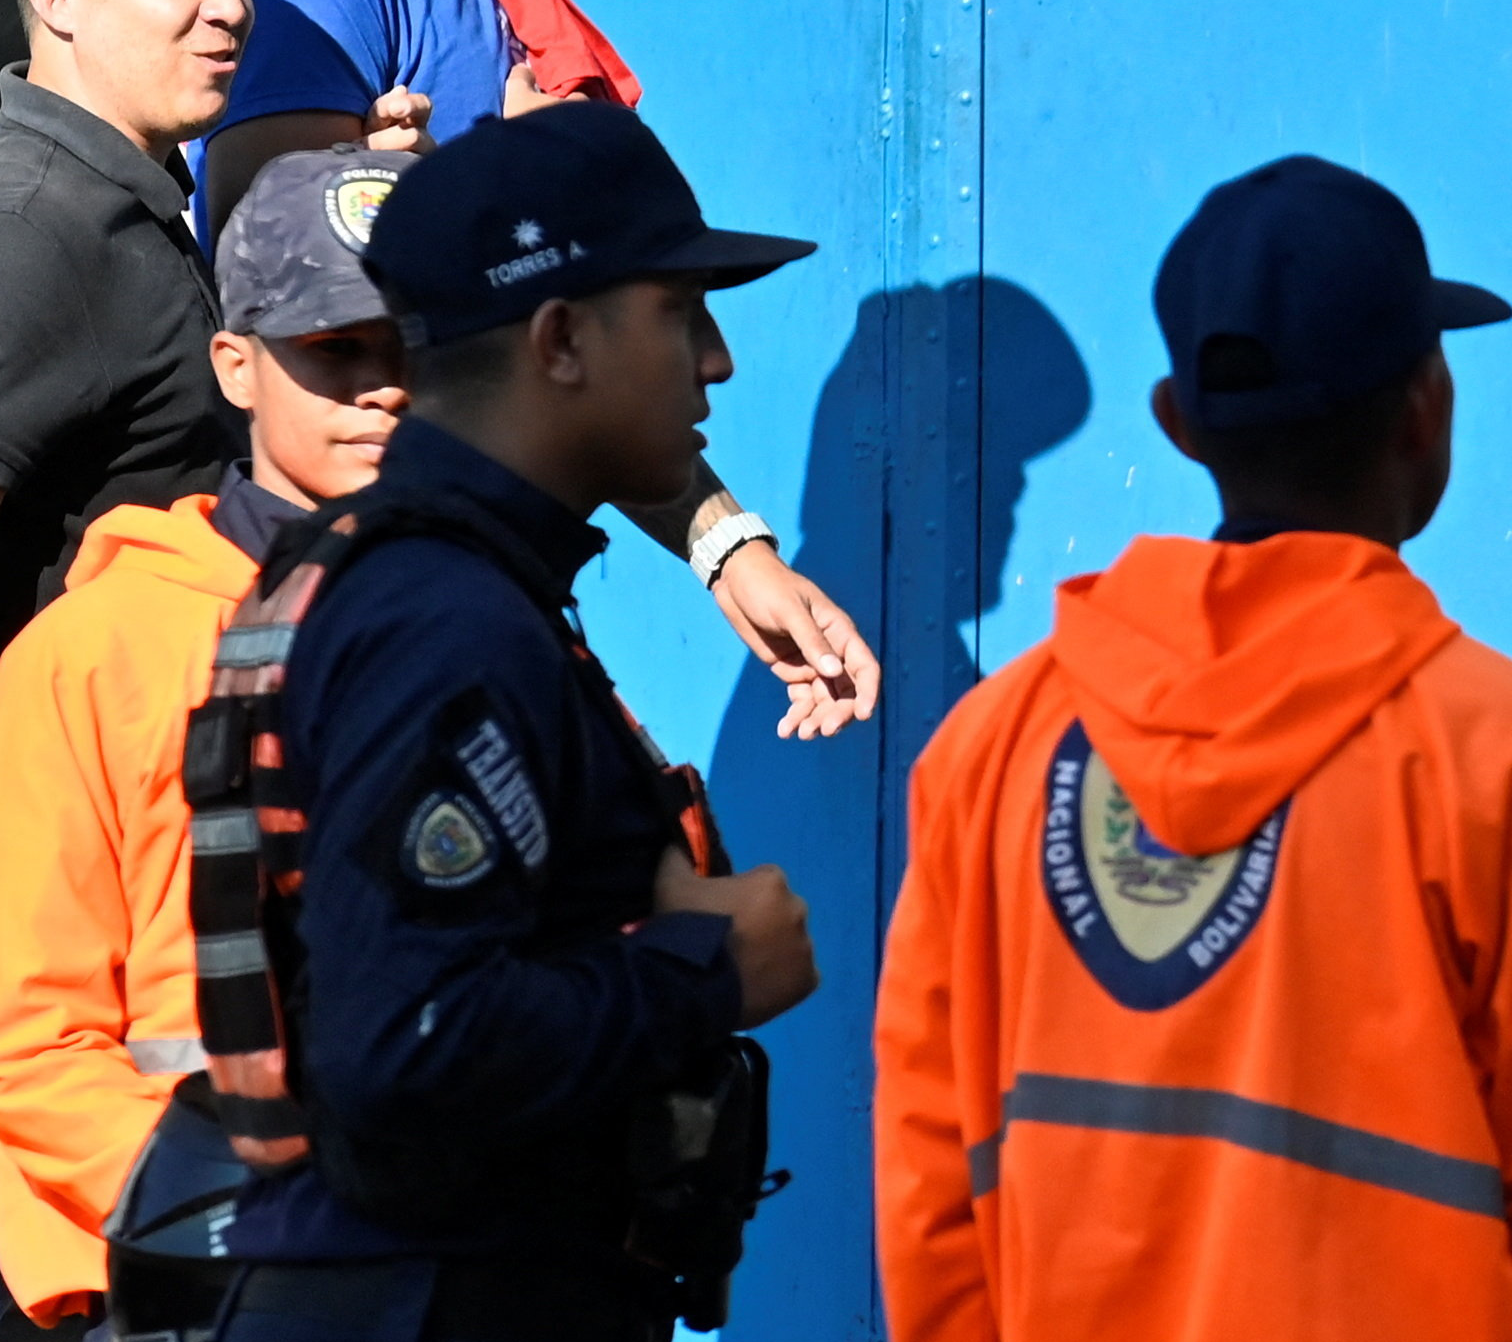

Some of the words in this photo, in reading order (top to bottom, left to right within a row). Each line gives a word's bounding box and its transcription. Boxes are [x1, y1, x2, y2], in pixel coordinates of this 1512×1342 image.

[484, 247, 562, 288] TORRES
[1045, 759, 1098, 939] NACIONAL
[1187, 817, 1280, 969] BOLIVARIA
